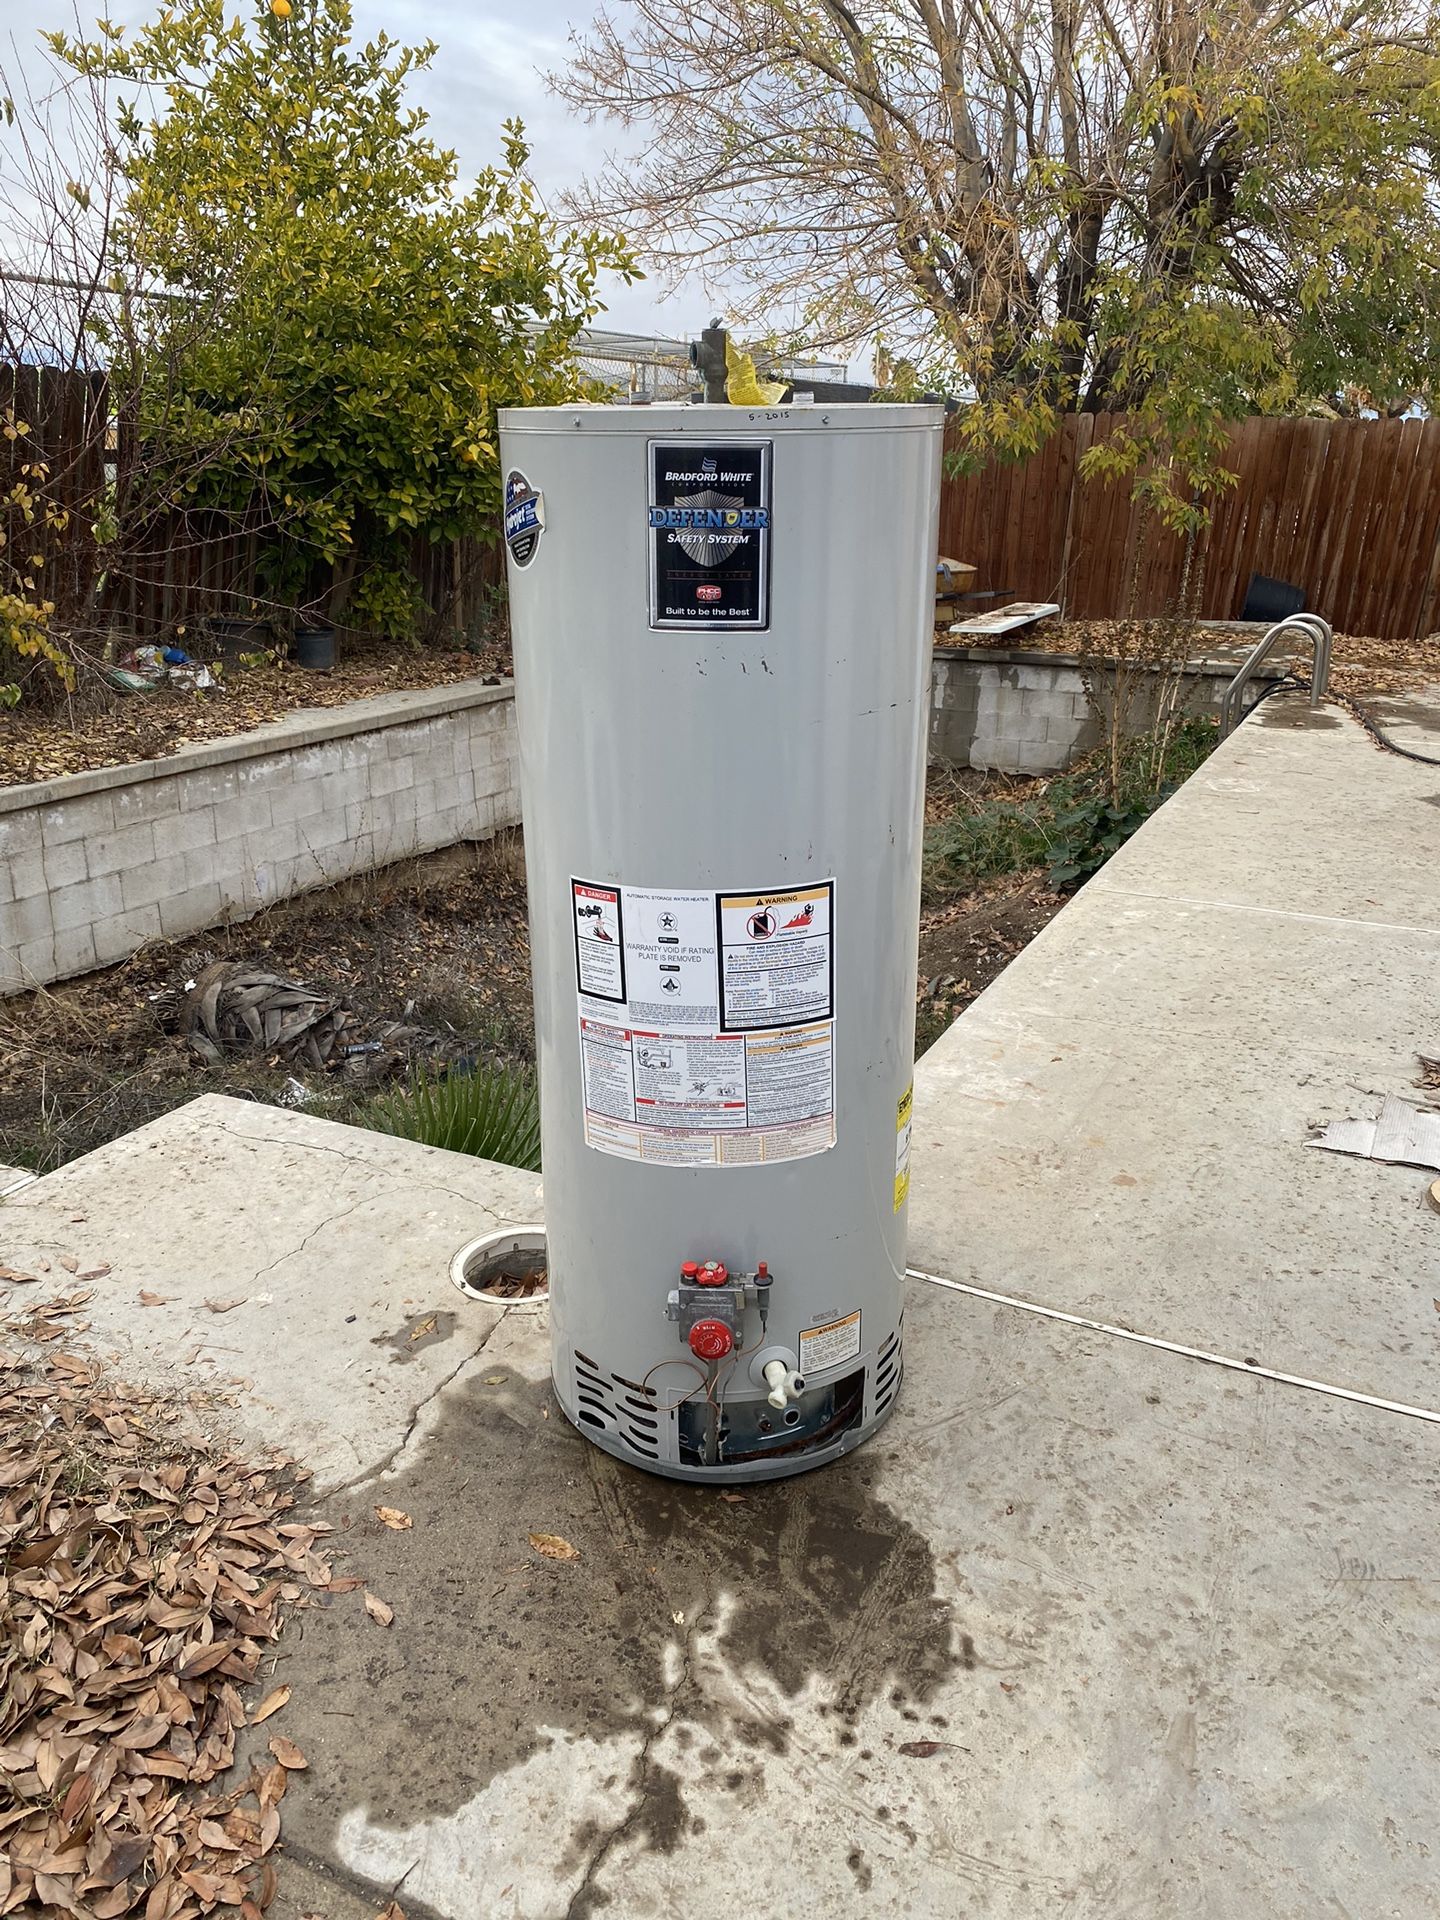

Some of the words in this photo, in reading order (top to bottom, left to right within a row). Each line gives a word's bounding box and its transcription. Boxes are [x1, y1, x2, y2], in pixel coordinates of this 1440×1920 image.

[665, 471, 718, 481] BRADFORD
[720, 472, 752, 482] WHITE
[650, 507, 769, 528] DEFENDER
[667, 533, 705, 543] SAFETY
[707, 534, 749, 544] SYSTEM
[666, 607, 685, 615] Built
[698, 607, 710, 615] be
[712, 608, 727, 616] the
[729, 608, 750, 616] Best
[587, 890, 611, 900] DANGER
[764, 895, 798, 905] WARNING
[626, 943, 661, 952] WARRANTY
[663, 946, 680, 954] VOID
[688, 947, 715, 955] RATING
[638, 952, 659, 961] PLATE
[668, 955, 702, 963] REMOVED
